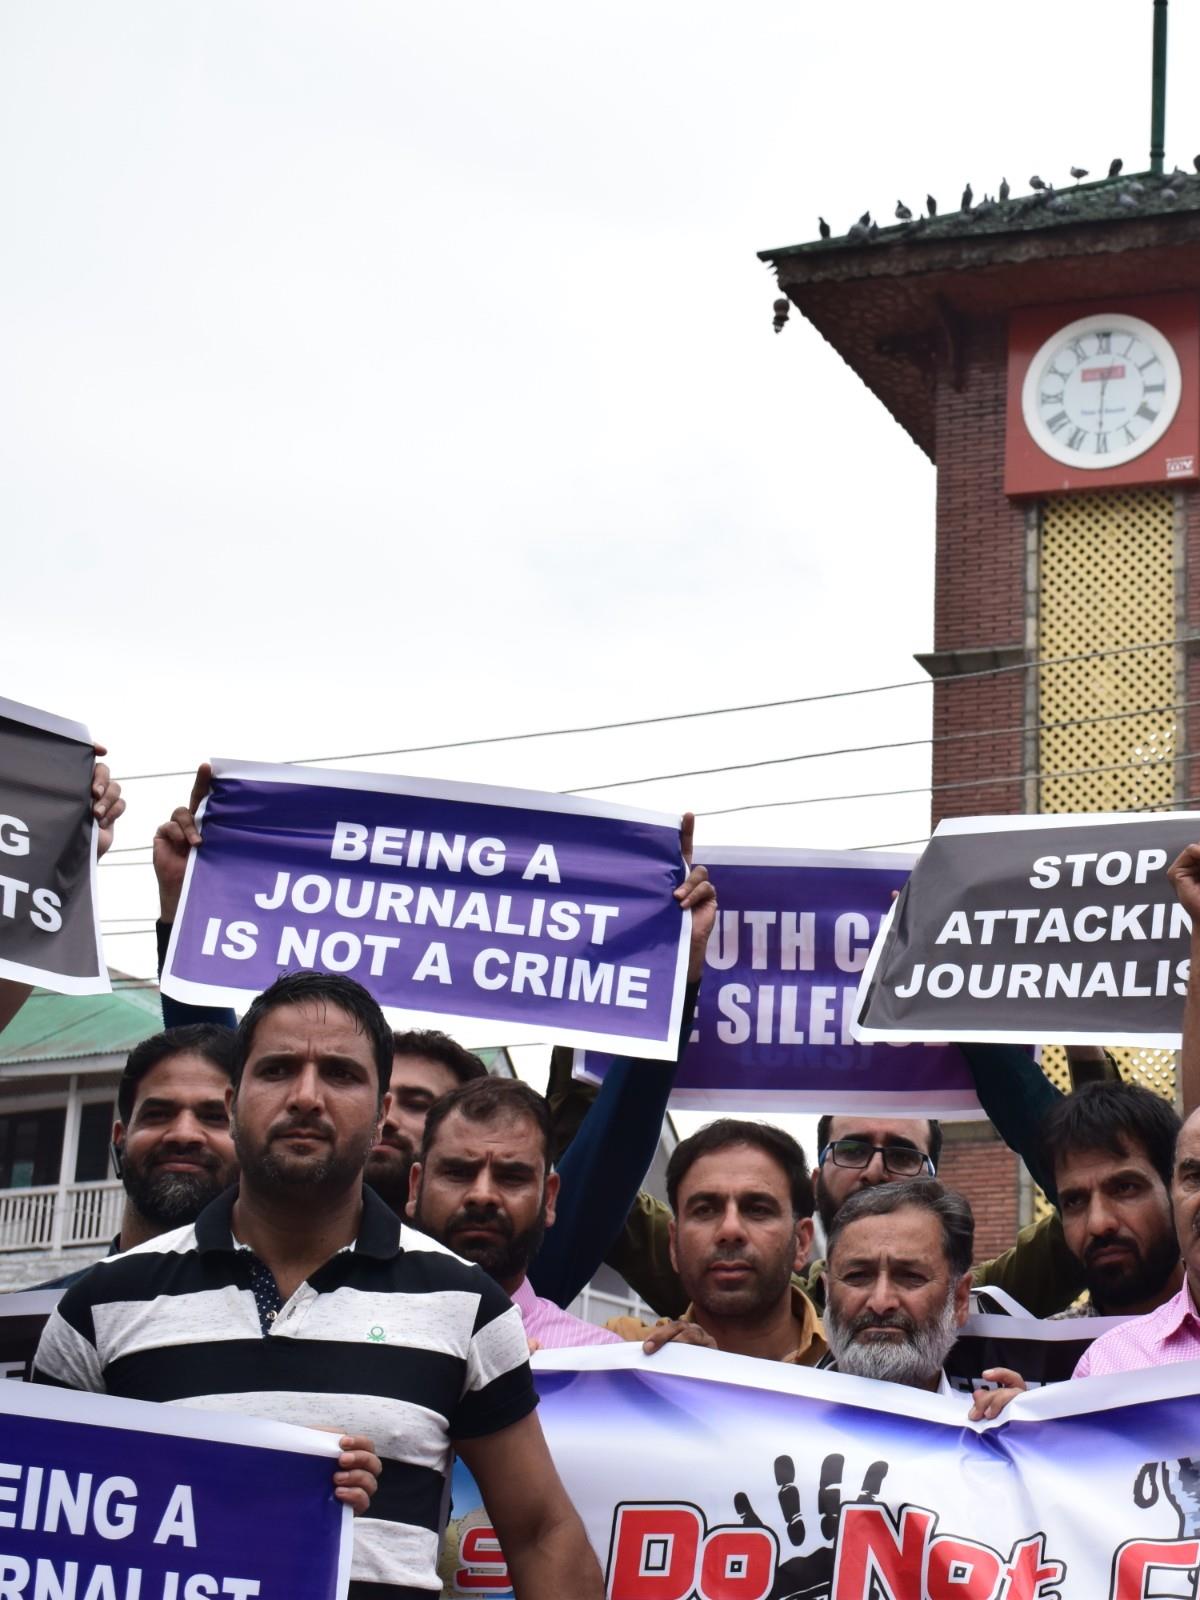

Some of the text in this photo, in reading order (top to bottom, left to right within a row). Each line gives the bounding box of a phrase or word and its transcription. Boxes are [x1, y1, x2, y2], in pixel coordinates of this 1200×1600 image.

[330, 821, 561, 884] BEING A
[1029, 849, 1168, 889] STOP
[254, 871, 620, 945] JOURNALIST
[201, 916, 651, 1010] IS NOT A CRIME
[154, 1485, 198, 1548] A
[605, 1501, 782, 1600] Do
[831, 1501, 1068, 1600] Not
